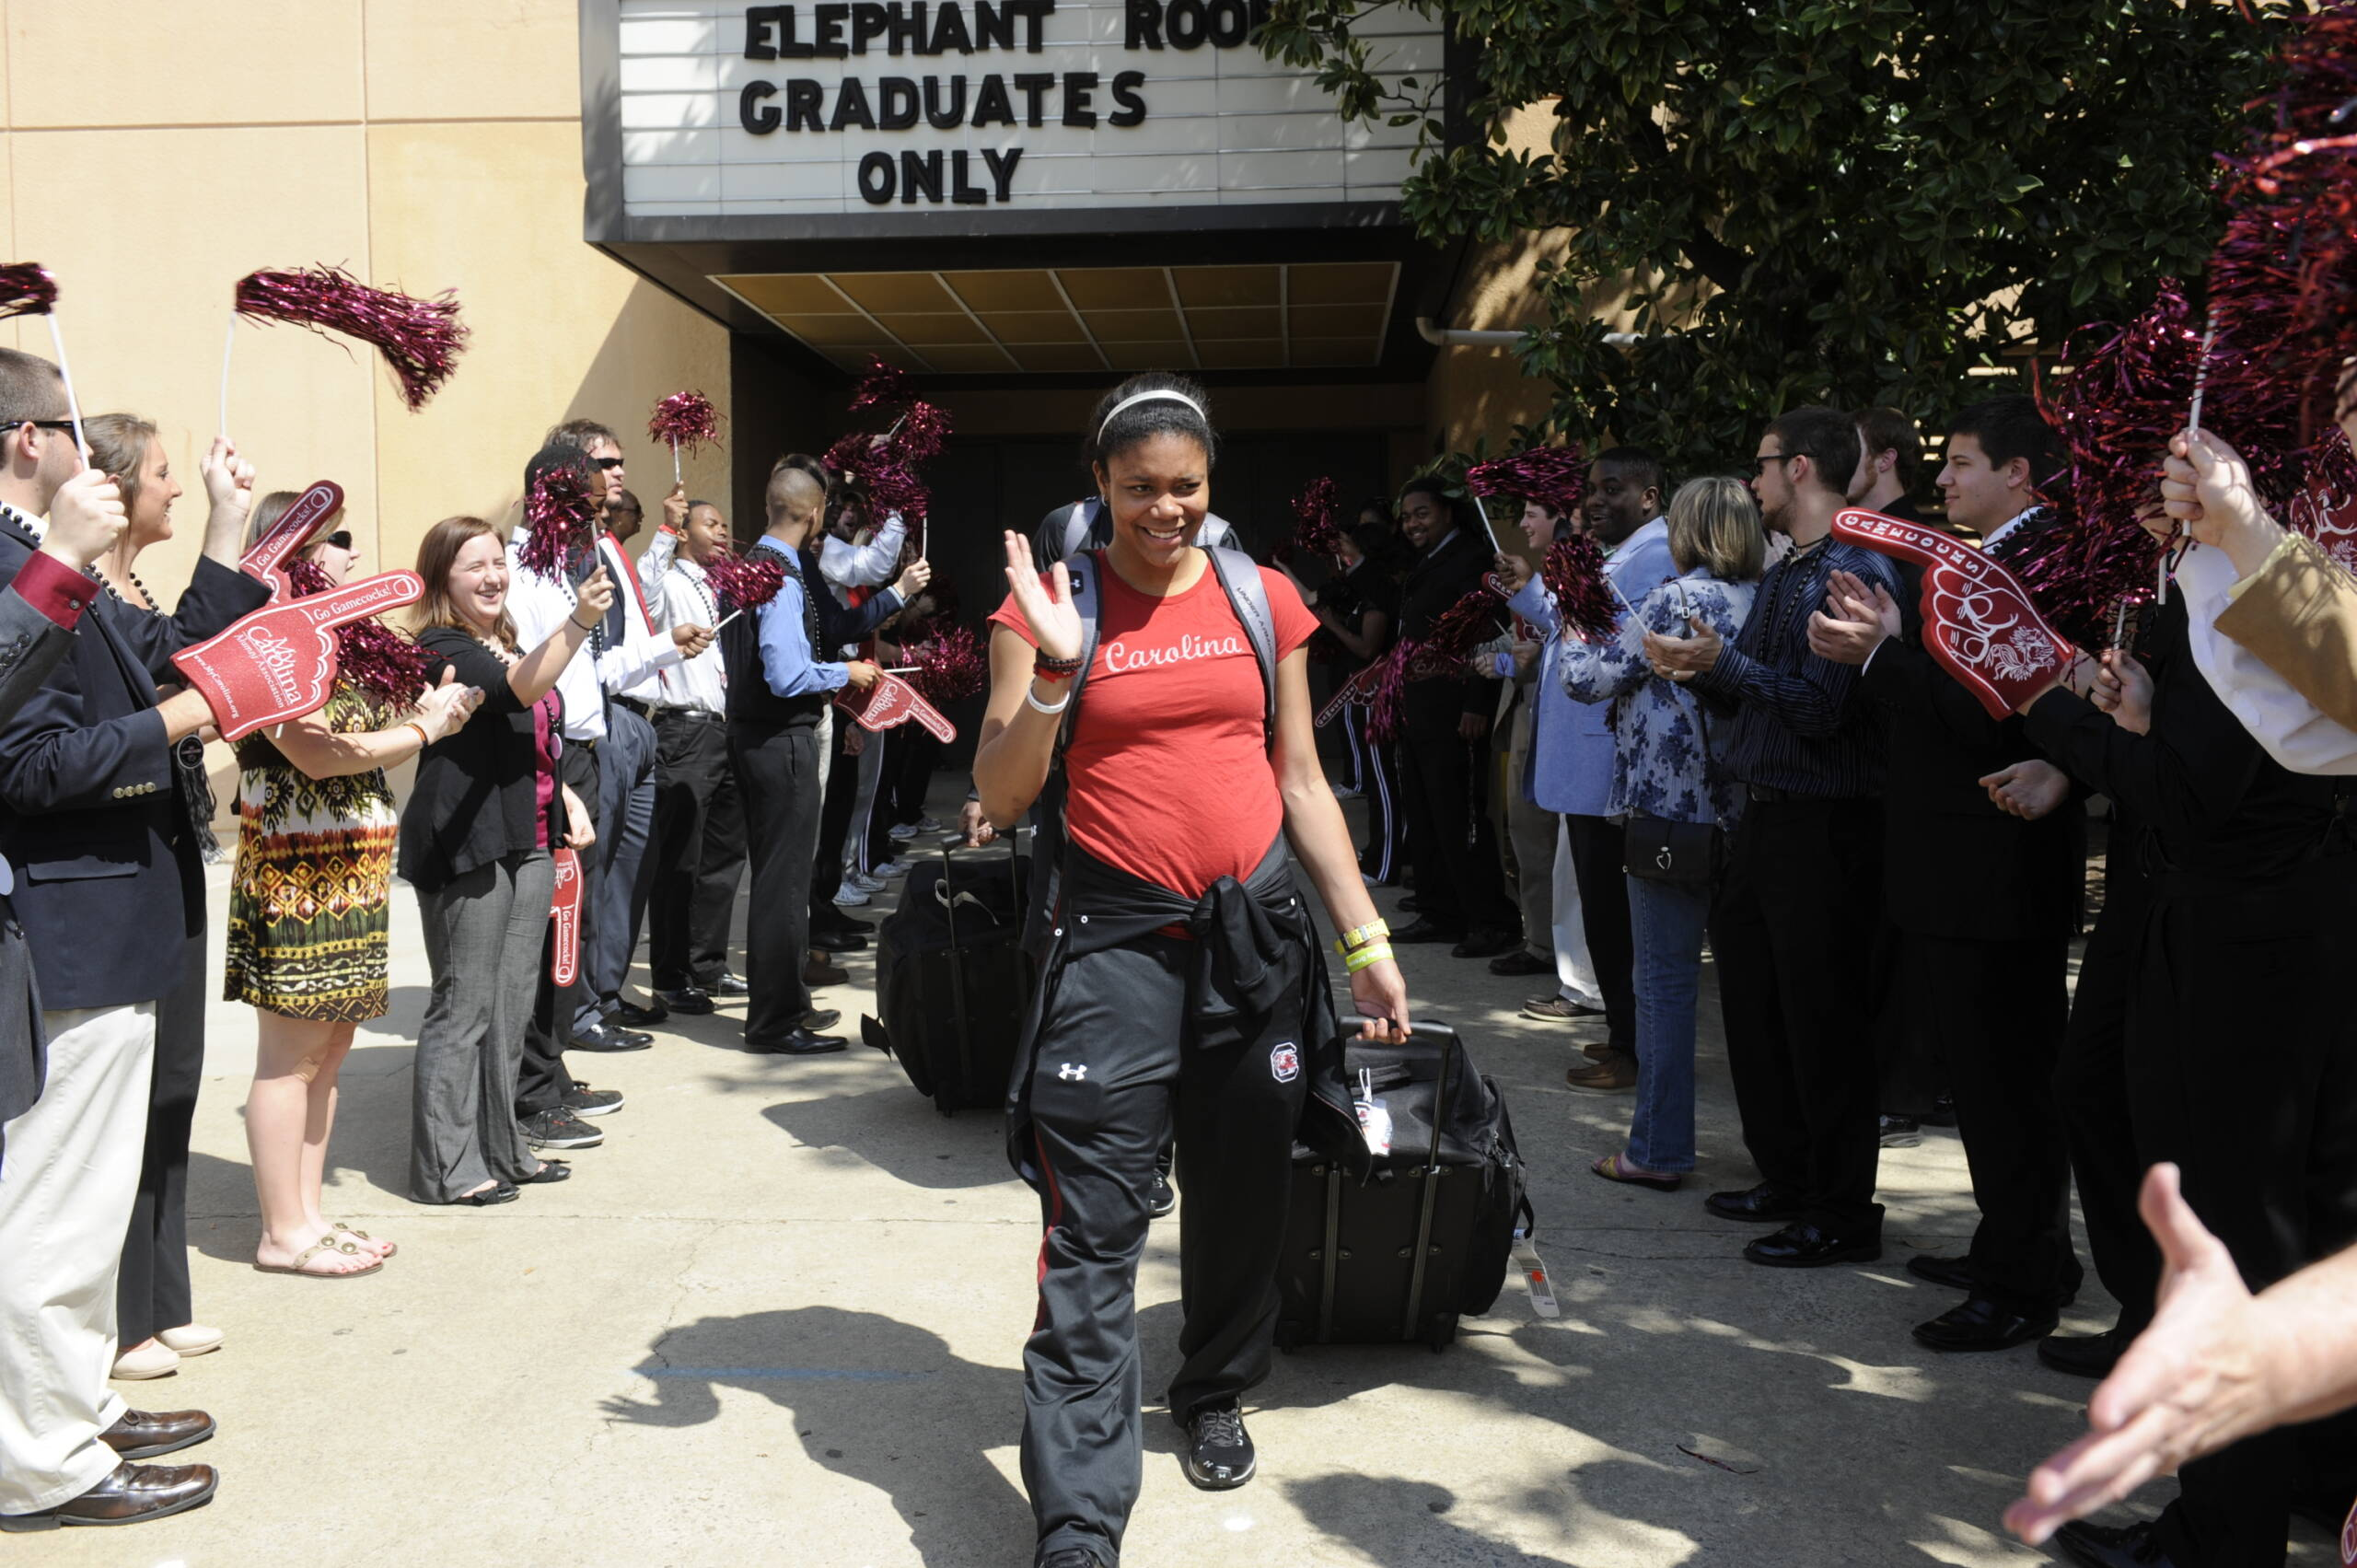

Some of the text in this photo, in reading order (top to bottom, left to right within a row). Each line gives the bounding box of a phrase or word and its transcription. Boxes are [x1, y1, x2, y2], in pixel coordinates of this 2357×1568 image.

[744, 0, 1054, 60] ELEPHANT
[740, 71, 1147, 134] GRADUATES
[858, 148, 1024, 204] ONLY
[256, 504, 313, 567] Go Gamecocks!
[1845, 515, 1980, 574] GAMECOCKS
[313, 583, 392, 621] Go Gamecocks!
[1237, 587, 1260, 618] UNDER
[233, 633, 284, 708] Alumni Association
[246, 625, 303, 704] Carolina
[1106, 633, 1243, 673] Carolina
